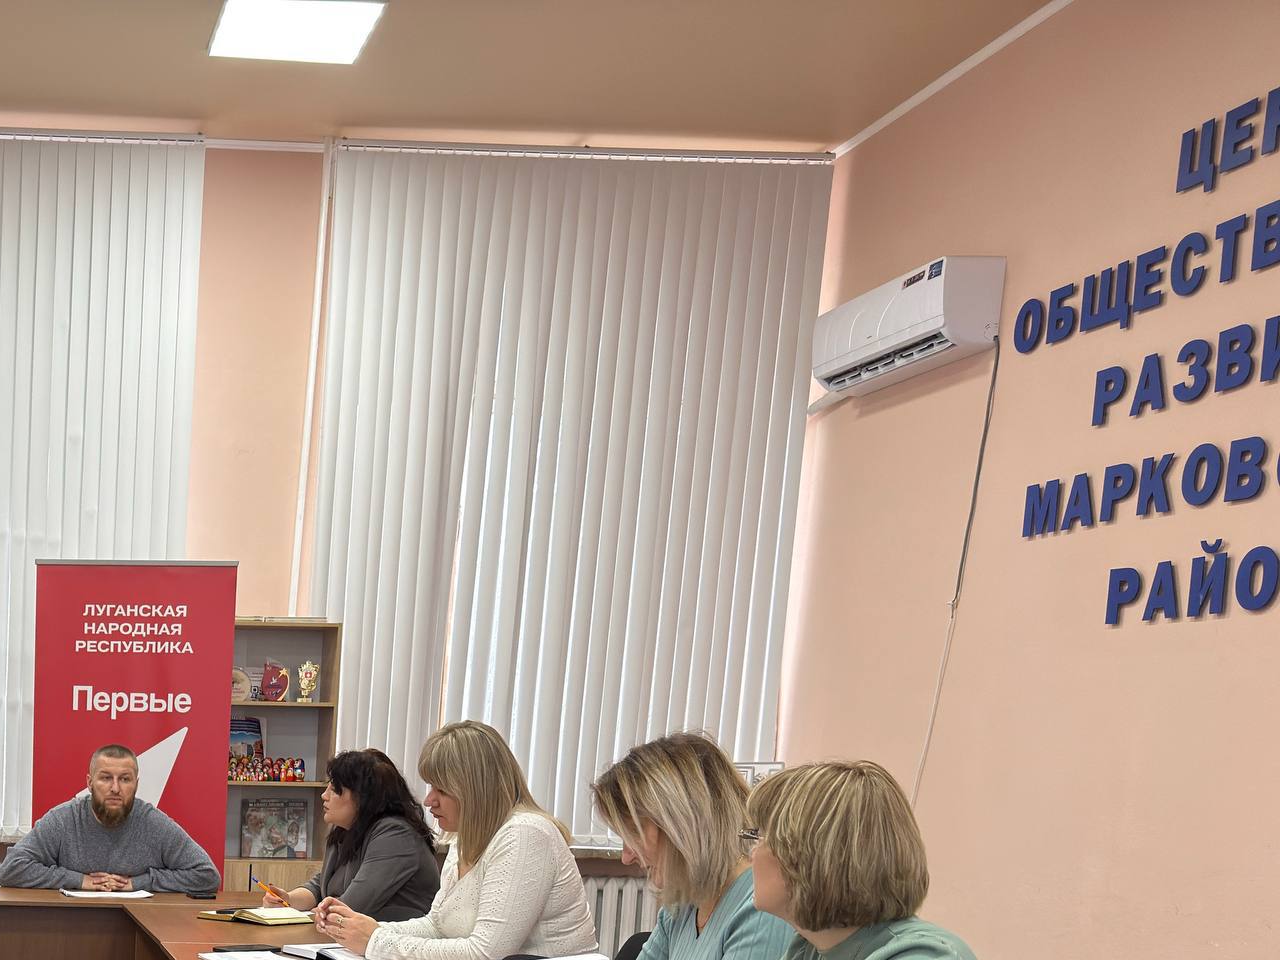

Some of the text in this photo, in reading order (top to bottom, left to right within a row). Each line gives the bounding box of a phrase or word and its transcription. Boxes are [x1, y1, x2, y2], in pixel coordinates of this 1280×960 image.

[1014, 200, 1280, 353] ОБЩЕСТВ
[1022, 436, 1280, 537] МАРКОВ
[1105, 539, 1280, 625] РАЙО
[83, 604, 187, 617] ЛУГАНСКАЯ
[75, 640, 194, 654] РЕСПУБЛИКА
[84, 622, 182, 637] НАРОДНАЯ
[72, 685, 192, 720] Первые
